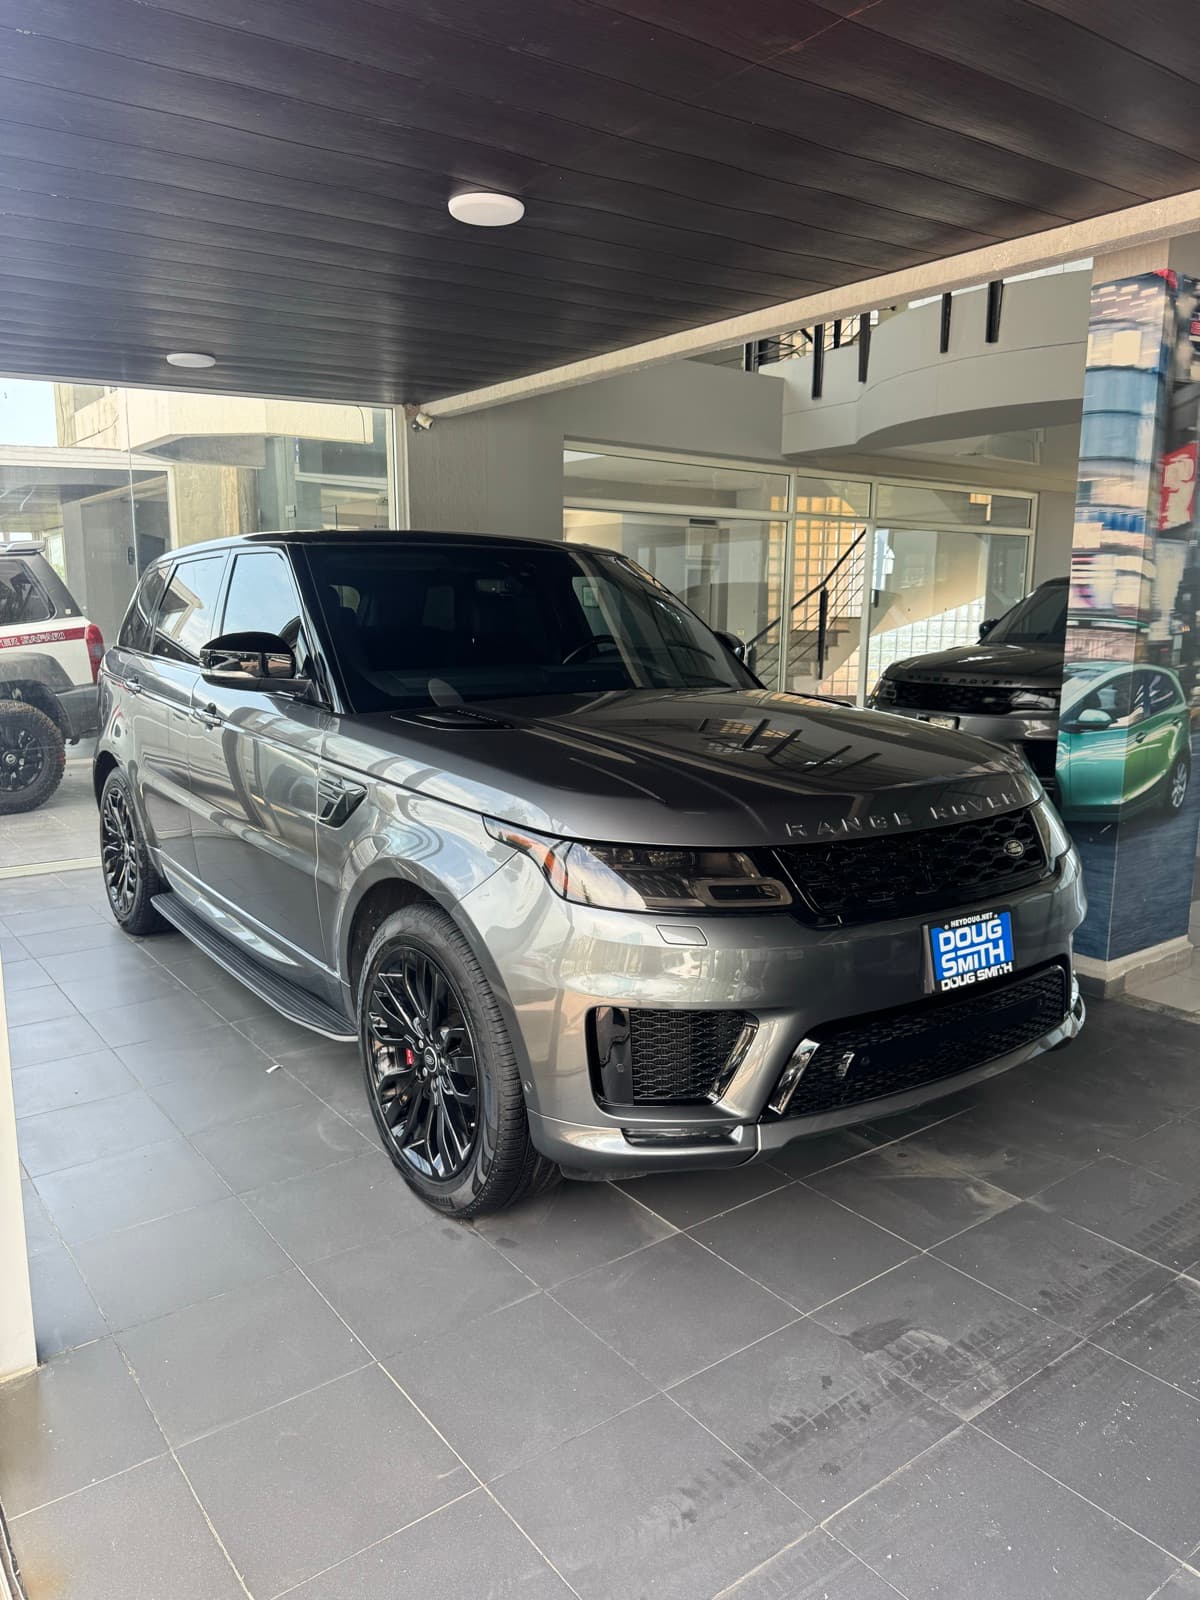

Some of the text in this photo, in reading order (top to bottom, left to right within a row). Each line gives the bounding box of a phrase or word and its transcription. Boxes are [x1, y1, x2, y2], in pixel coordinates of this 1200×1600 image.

[785, 792, 1017, 837] RANGE ROVER
[938, 919, 1003, 953] DOUG
[950, 912, 993, 928] HEYDOUG.NET
[941, 939, 1005, 978] SMITH
[940, 961, 1013, 991] DOUG SMITH
